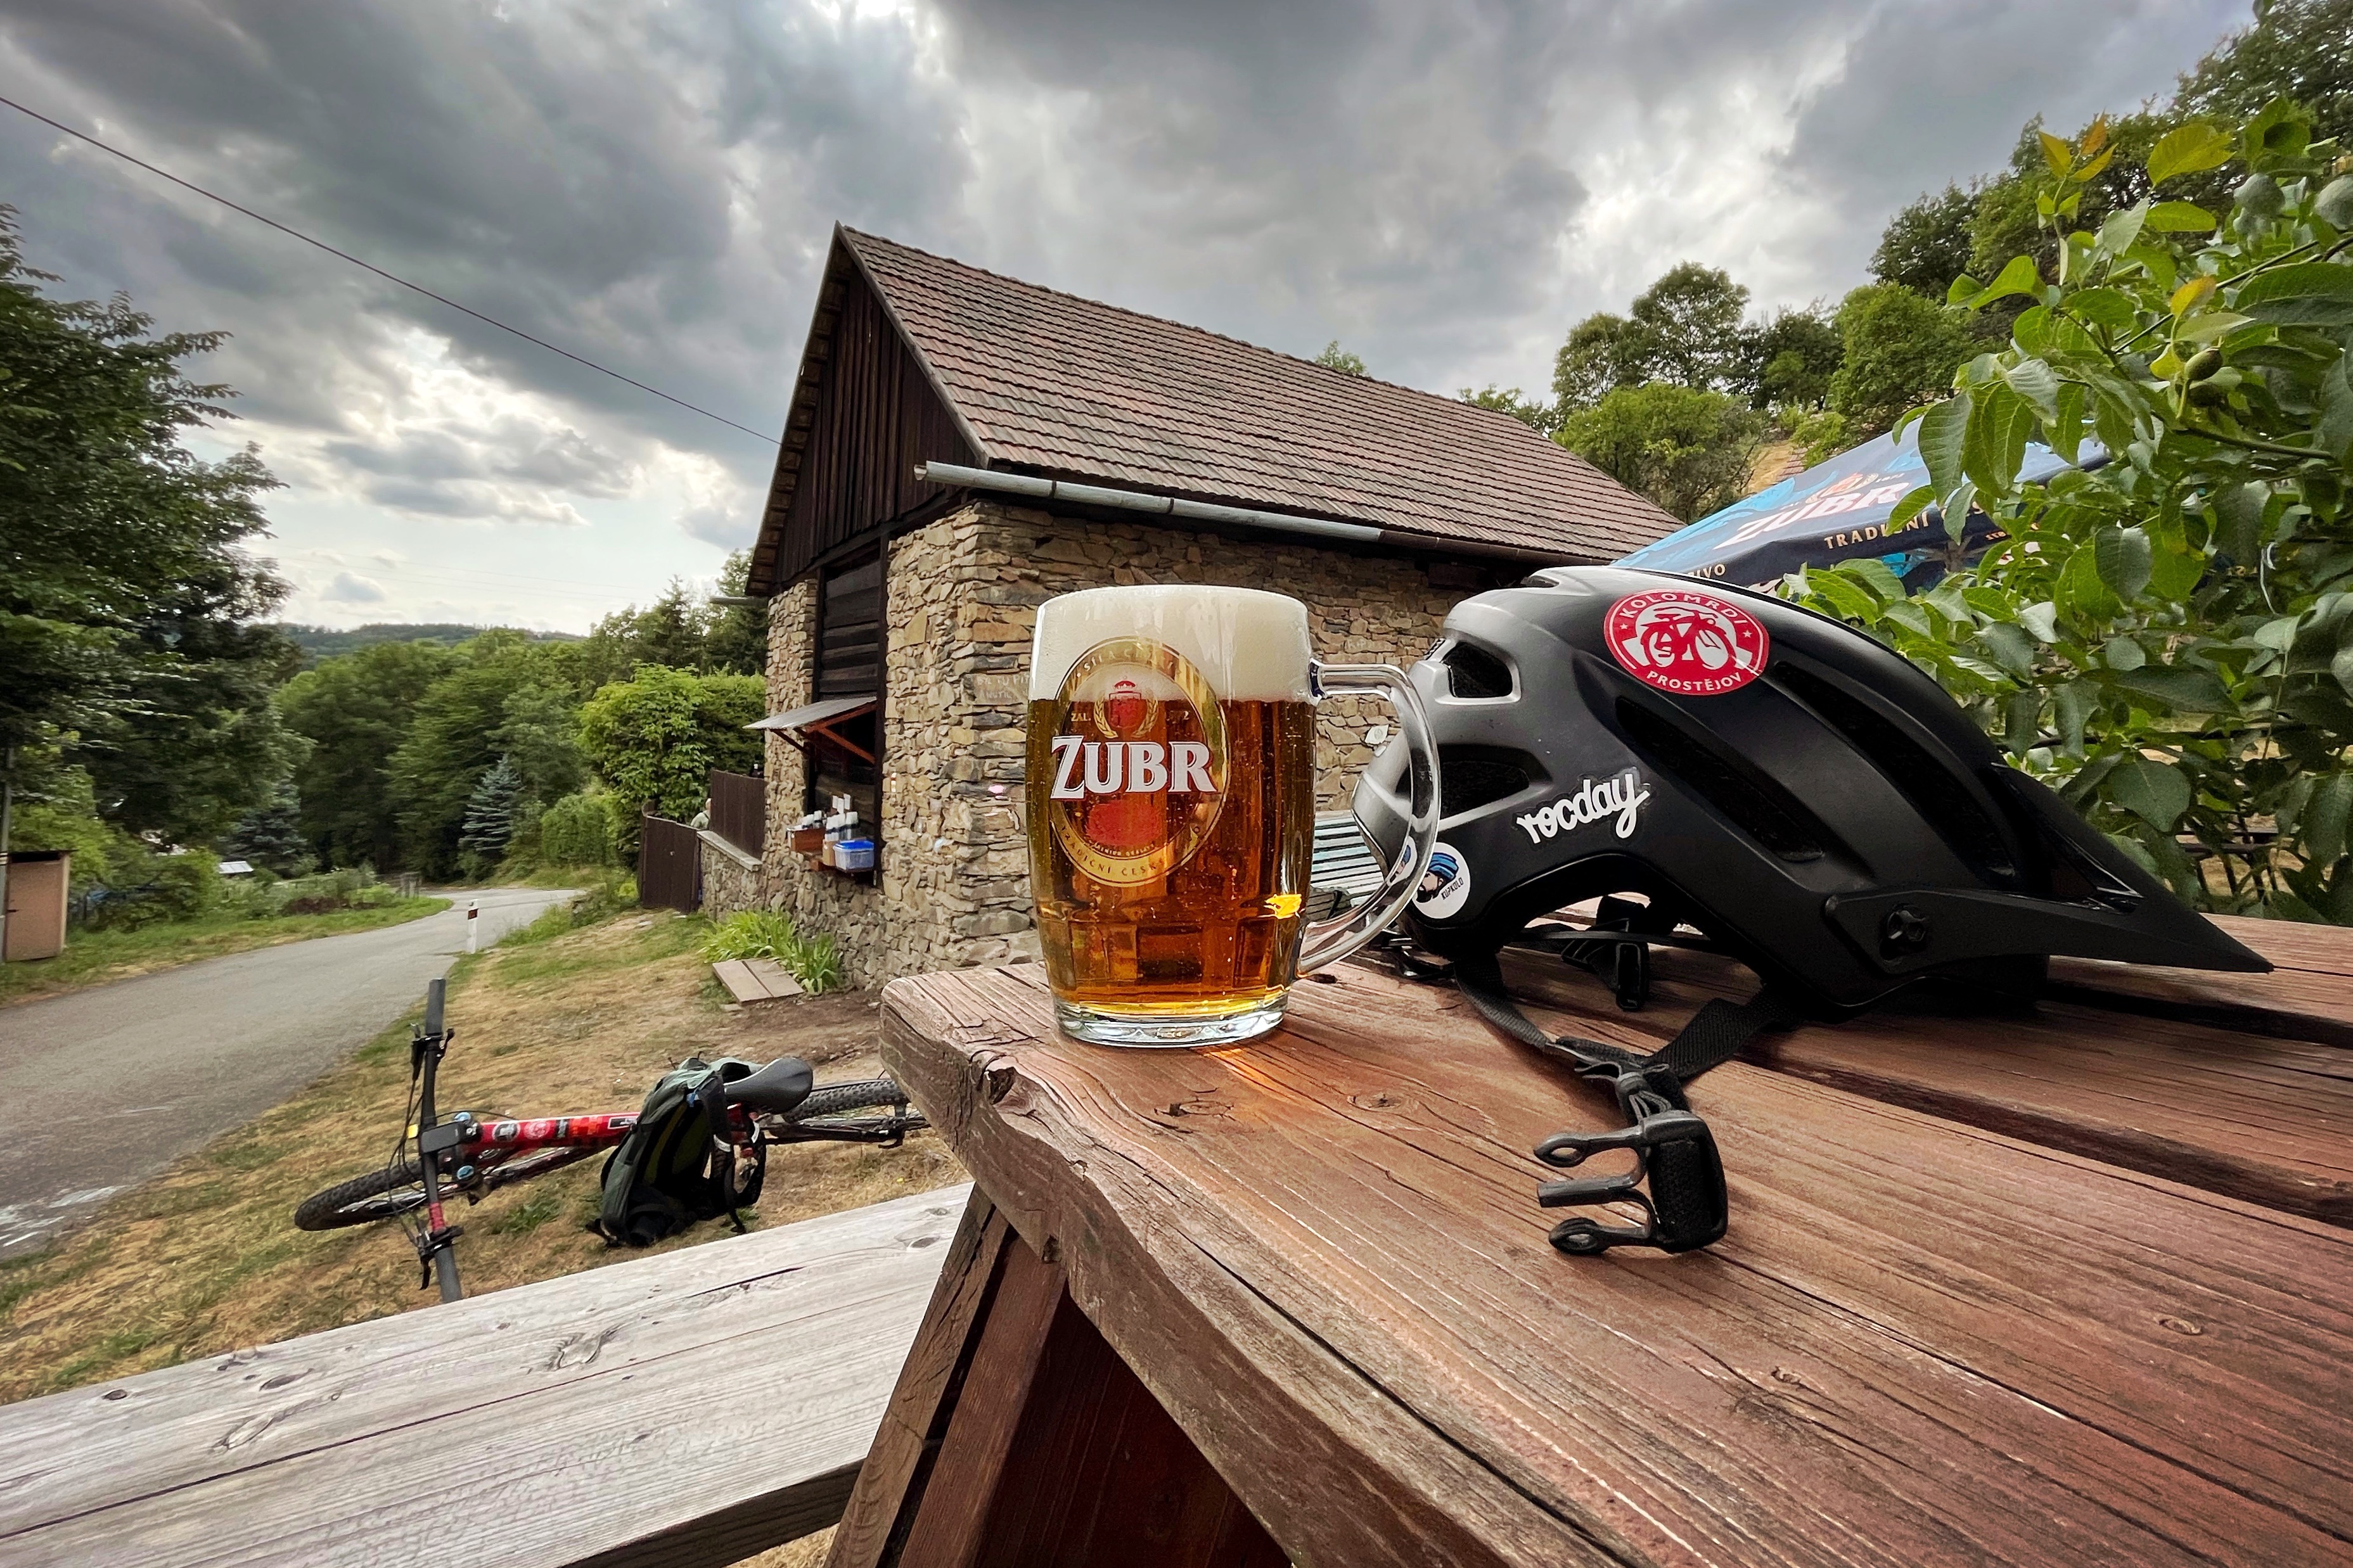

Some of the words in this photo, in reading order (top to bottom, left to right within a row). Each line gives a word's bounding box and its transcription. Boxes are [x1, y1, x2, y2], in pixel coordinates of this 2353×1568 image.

[1713, 482, 1909, 550] ZUBR
[1824, 510, 1928, 549] TRADINÍ
[1619, 592, 1748, 624] KOLOMRDI
[1646, 670, 1741, 691] PROSTĚJOV
[1050, 735, 1217, 800] ZUBR
[1516, 773, 1650, 844] rocday
[1441, 877, 1464, 900] KUPKOLO
